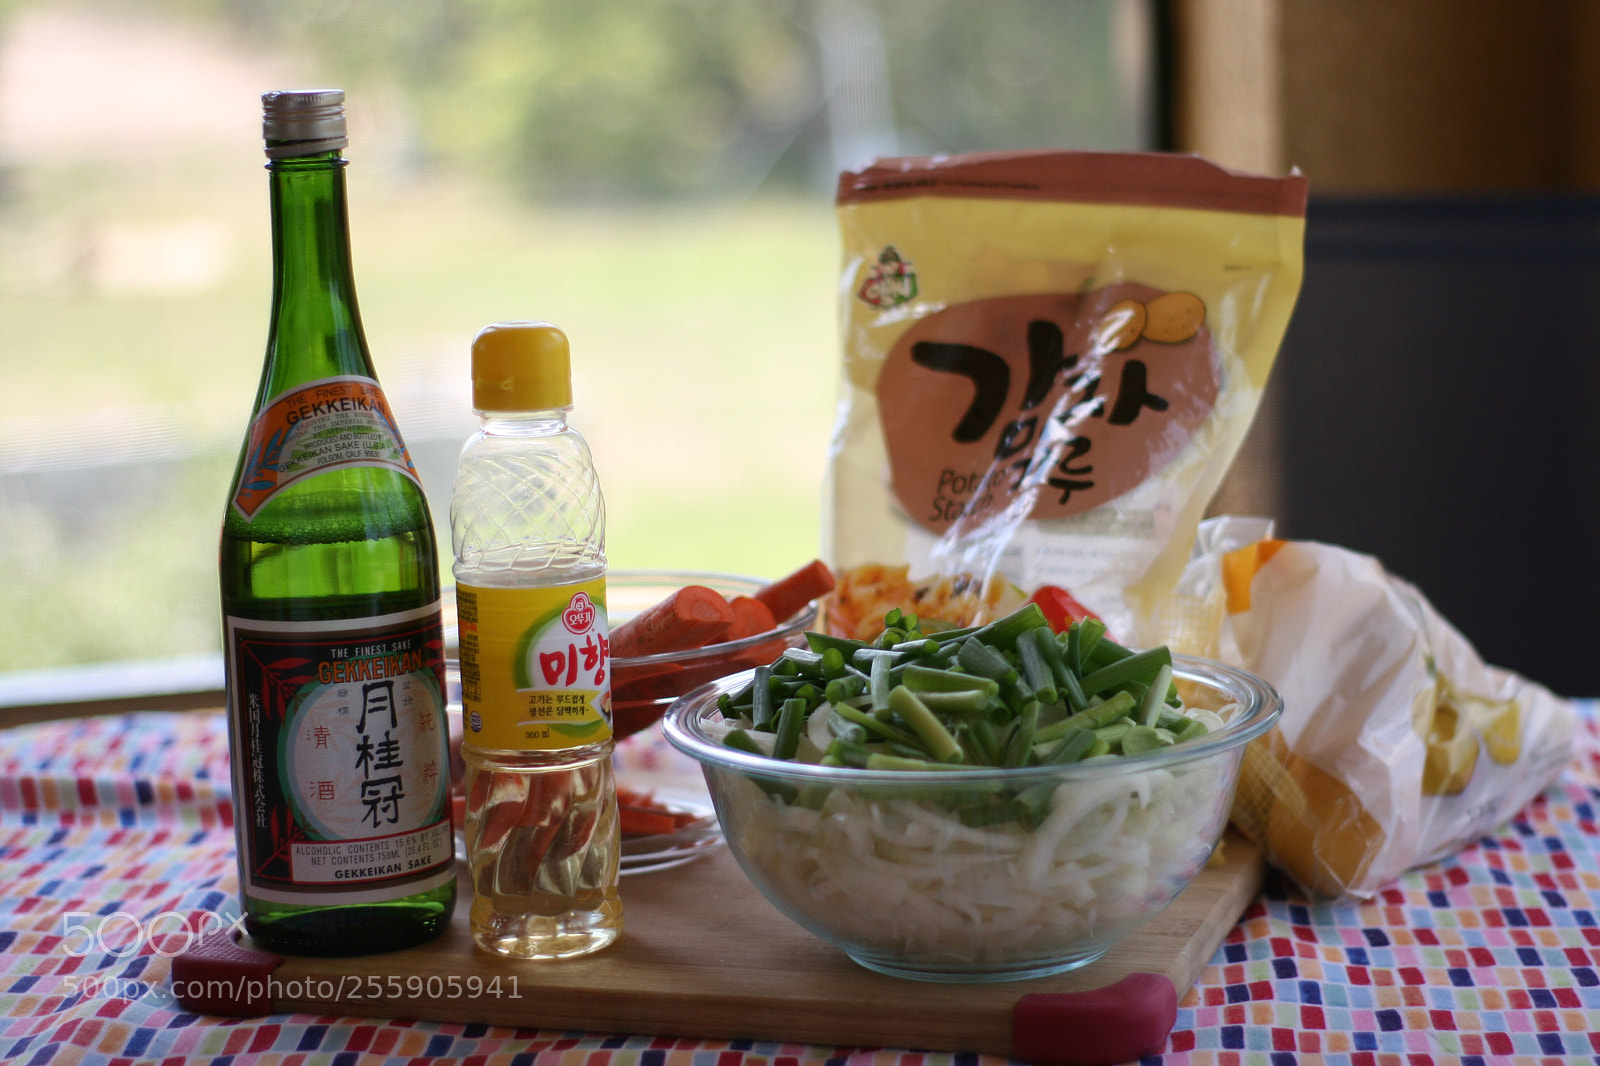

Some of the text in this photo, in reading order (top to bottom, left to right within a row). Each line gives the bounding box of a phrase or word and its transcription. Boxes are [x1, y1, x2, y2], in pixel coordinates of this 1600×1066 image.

[286, 385, 380, 409] THE FINEST SAKE
[286, 397, 385, 425] GEKKEIKAN
[313, 422, 327, 431] THE
[331, 419, 363, 428] IMPERIAL
[304, 435, 339, 451] PRODUCED
[339, 432, 353, 440] AND
[353, 432, 378, 440] BOTTLED
[278, 444, 333, 473] GEKKEIKAN
[335, 441, 360, 452] SAKE
[569, 611, 591, 626] 오뚜기
[331, 639, 412, 659] THE FINEST SAKE
[539, 633, 610, 687] 미향
[318, 649, 423, 684] GEKKEIKAN
[528, 695, 554, 704] 고기는
[528, 706, 554, 717] 생선은
[525, 731, 540, 739] 360
[306, 725, 335, 801] 清酒
[354, 680, 406, 829] 月桂冠
[295, 846, 341, 856] ALCOHOLIC
[347, 842, 390, 854] CONTENTS
[395, 837, 417, 848] 15.6%
[420, 834, 430, 843] BY
[311, 856, 327, 866] NET
[331, 853, 374, 866] CONTENTS
[377, 851, 401, 862] 750ML
[334, 855, 432, 879] GEKKEIKAN SAKE
